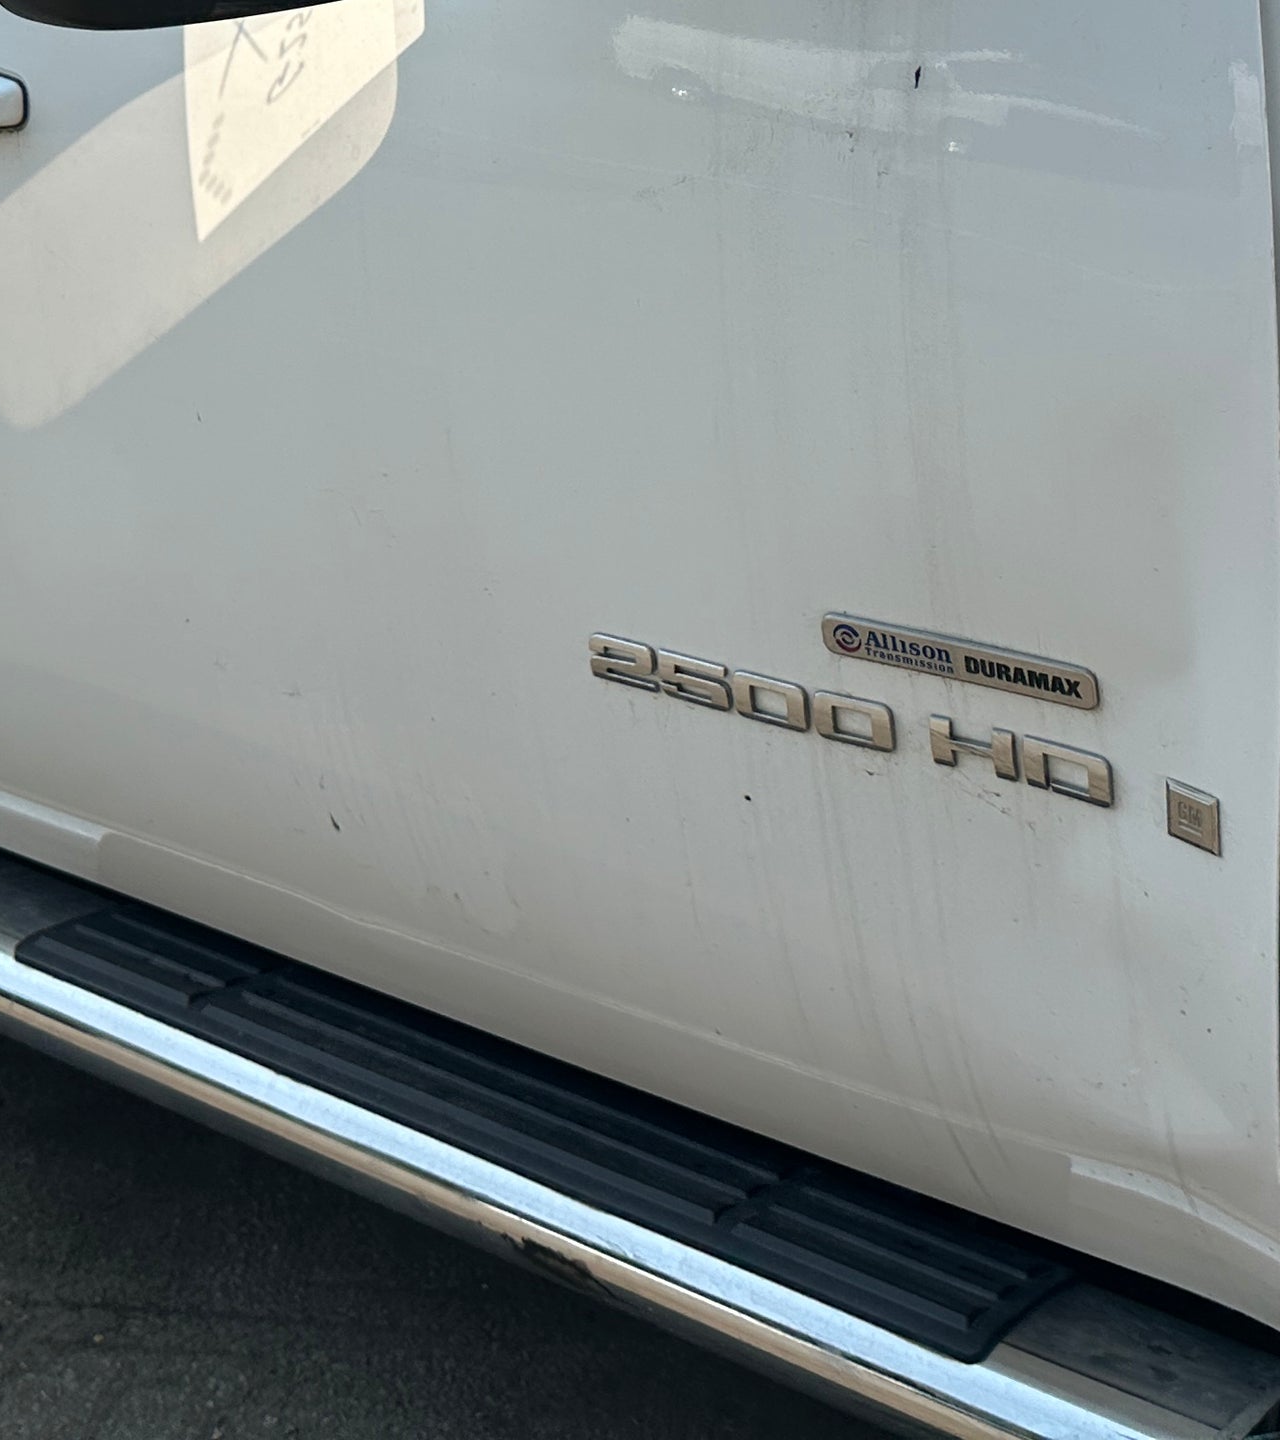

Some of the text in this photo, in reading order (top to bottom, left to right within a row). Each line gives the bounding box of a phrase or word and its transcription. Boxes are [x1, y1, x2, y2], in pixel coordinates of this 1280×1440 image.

[864, 646, 955, 675] Transmission
[864, 630, 1083, 700] Allison DURAMAX
[588, 631, 1115, 808] 2500 HD
